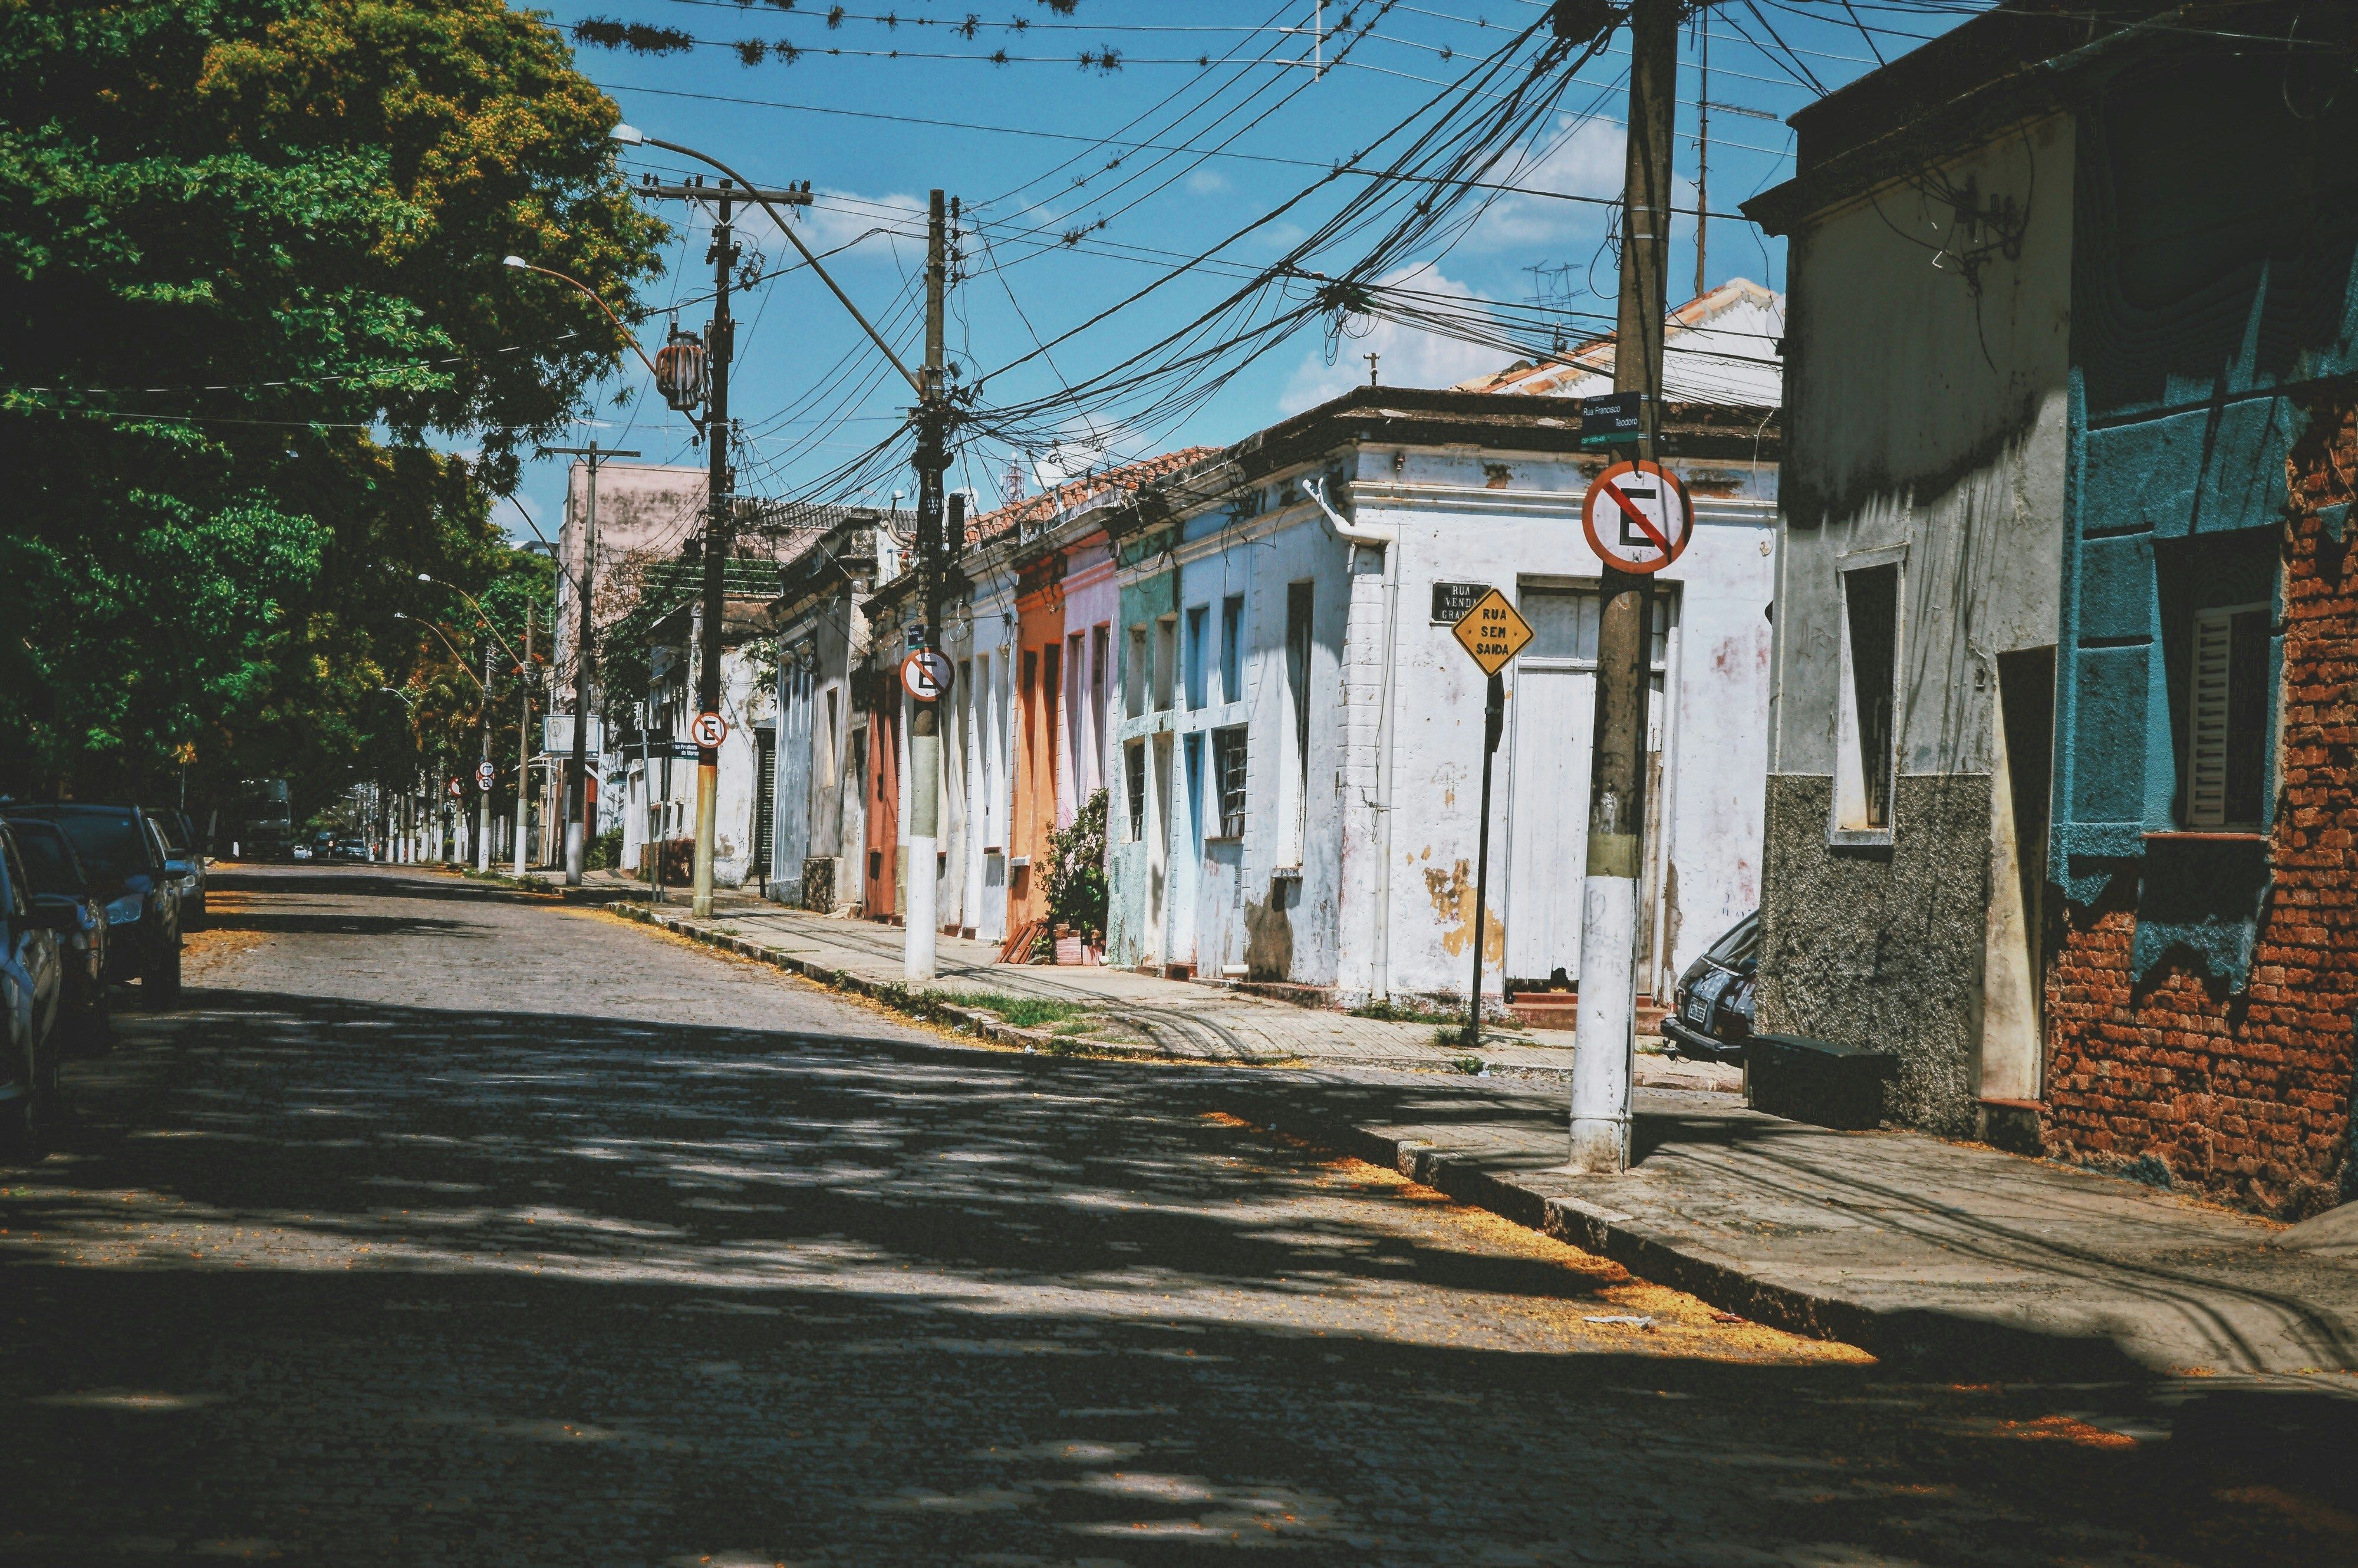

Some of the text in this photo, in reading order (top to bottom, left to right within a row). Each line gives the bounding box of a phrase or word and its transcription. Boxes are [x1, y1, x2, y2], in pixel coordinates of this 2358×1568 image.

[1595, 406, 1621, 414] Francisco
[1615, 418, 1638, 427] Teodoro
[1619, 488, 1656, 547] E
[1453, 585, 1470, 595] RUA
[1483, 608, 1507, 620] RUA
[1481, 625, 1506, 638] SEM
[1476, 643, 1509, 655] SAIDA
[918, 661, 937, 689] E
[703, 720, 716, 740] E
